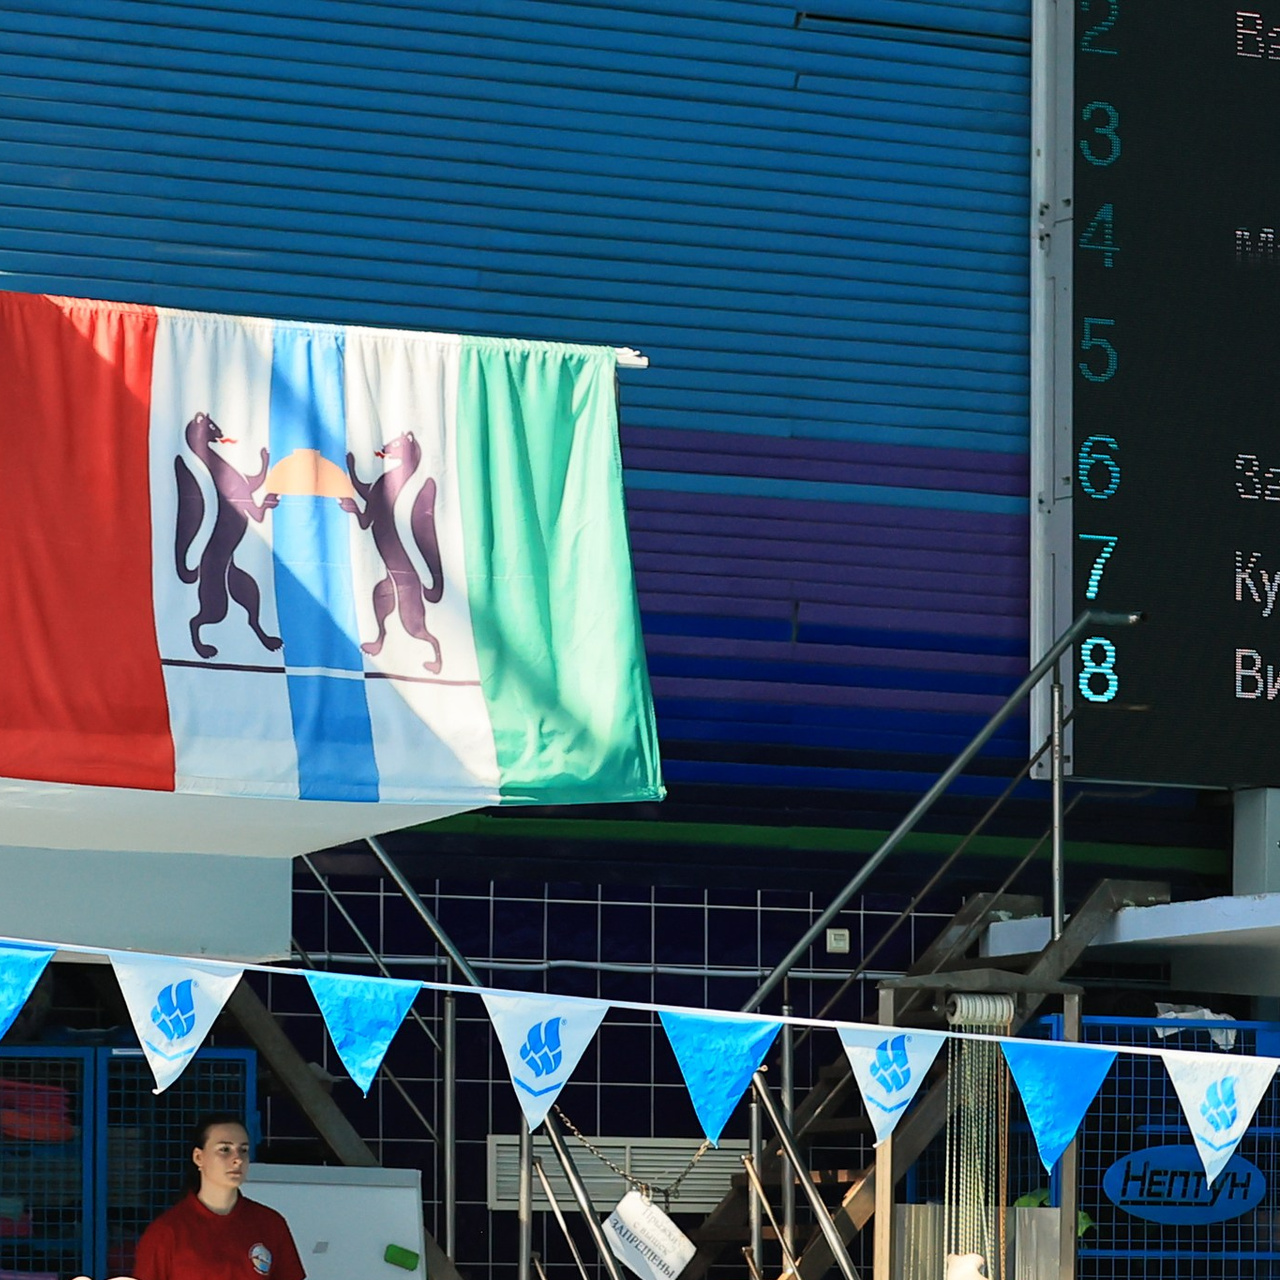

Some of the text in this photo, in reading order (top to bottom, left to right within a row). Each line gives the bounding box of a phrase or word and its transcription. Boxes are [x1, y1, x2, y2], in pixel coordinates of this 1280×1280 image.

[1080, 0, 1118, 55] 2
[1079, 101, 1121, 167] 3
[1079, 203, 1121, 269] 4
[1079, 317, 1119, 383] 5
[1078, 434, 1121, 500] 6
[1078, 534, 1118, 600] 7
[1078, 637, 1118, 702] 8
[610, 1218, 676, 1279] ЗАПРЕЩЕНЫ
